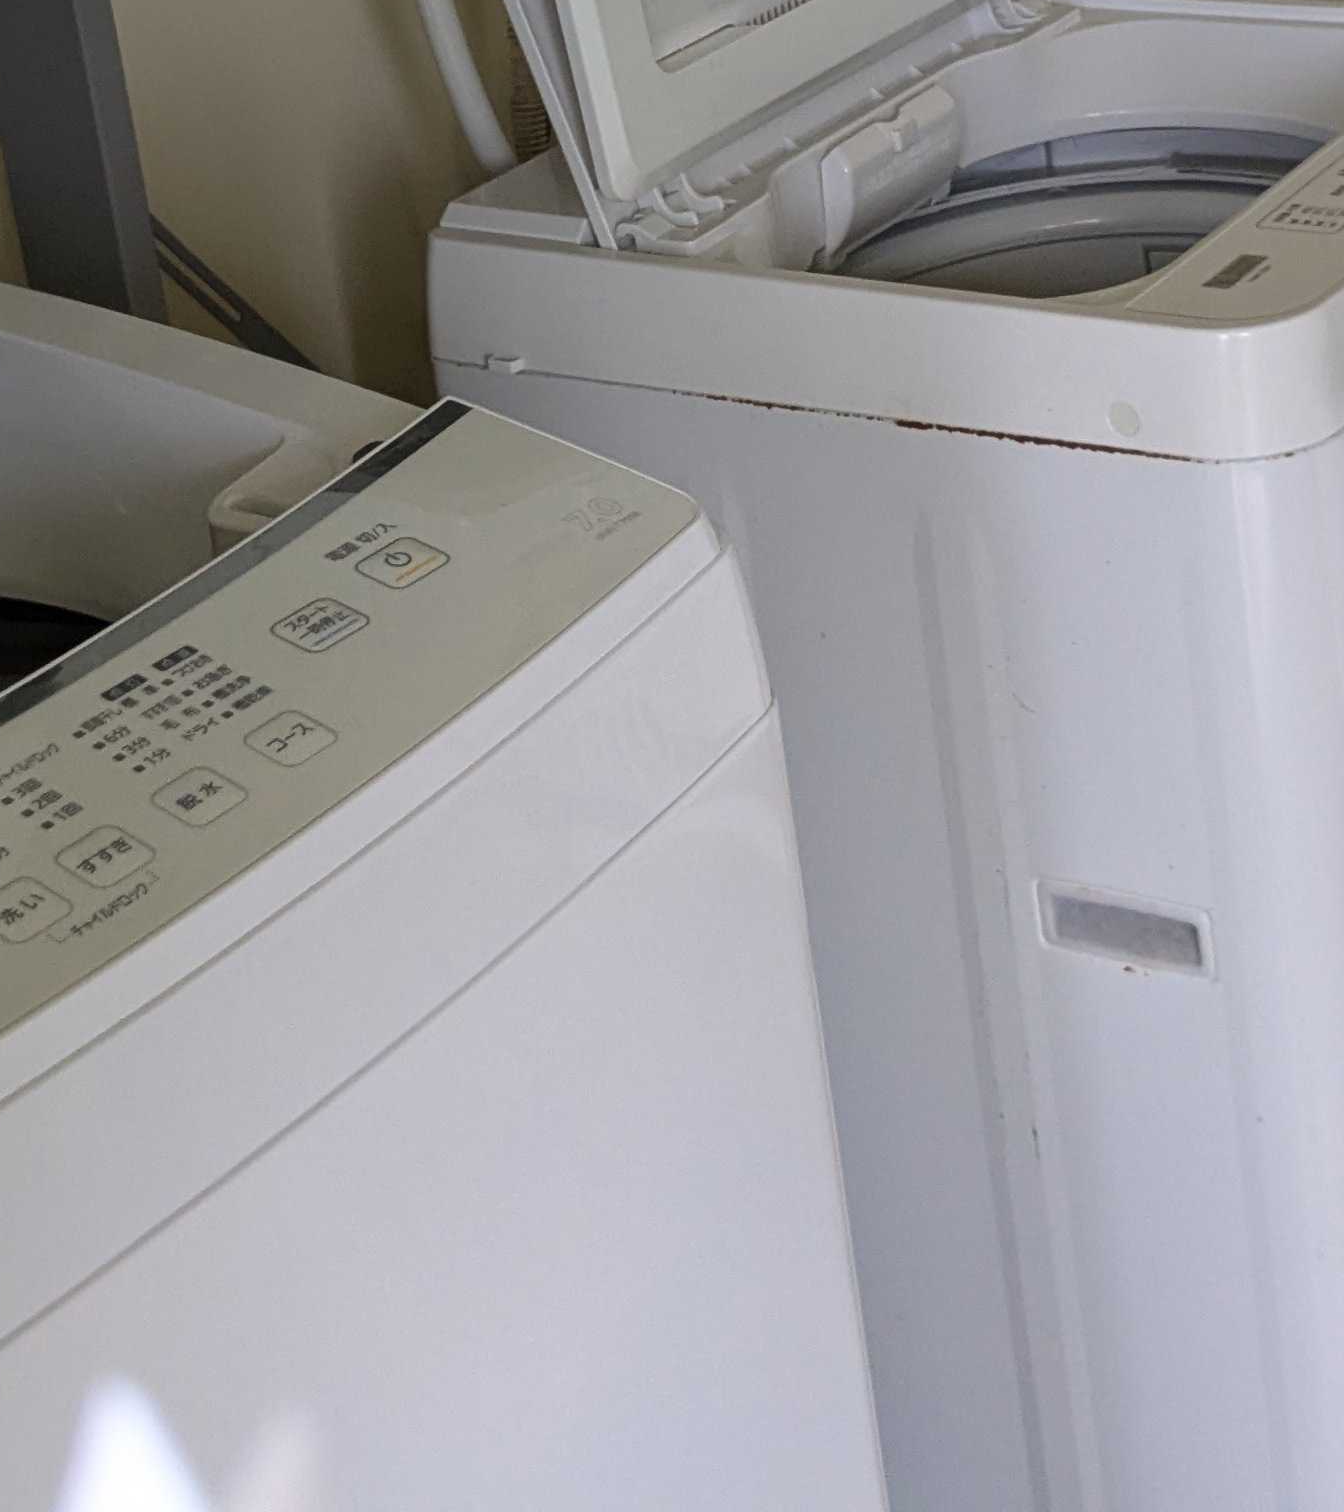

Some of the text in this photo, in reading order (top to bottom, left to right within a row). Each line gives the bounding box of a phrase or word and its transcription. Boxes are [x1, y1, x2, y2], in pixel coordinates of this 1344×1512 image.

[283, 602, 332, 633] スタート
[299, 611, 349, 641] 一時停止
[103, 724, 131, 745] 6分
[181, 716, 221, 743] ドライ
[265, 721, 316, 754] コース
[121, 735, 152, 757] 3分
[143, 747, 172, 767] 1分
[11, 776, 43, 800] 3回
[31, 788, 64, 811] 2回
[175, 779, 224, 812] 脱水
[53, 800, 85, 822] 1回
[75, 836, 134, 875] すすぎ
[69, 882, 149, 937] チャイルドロック
